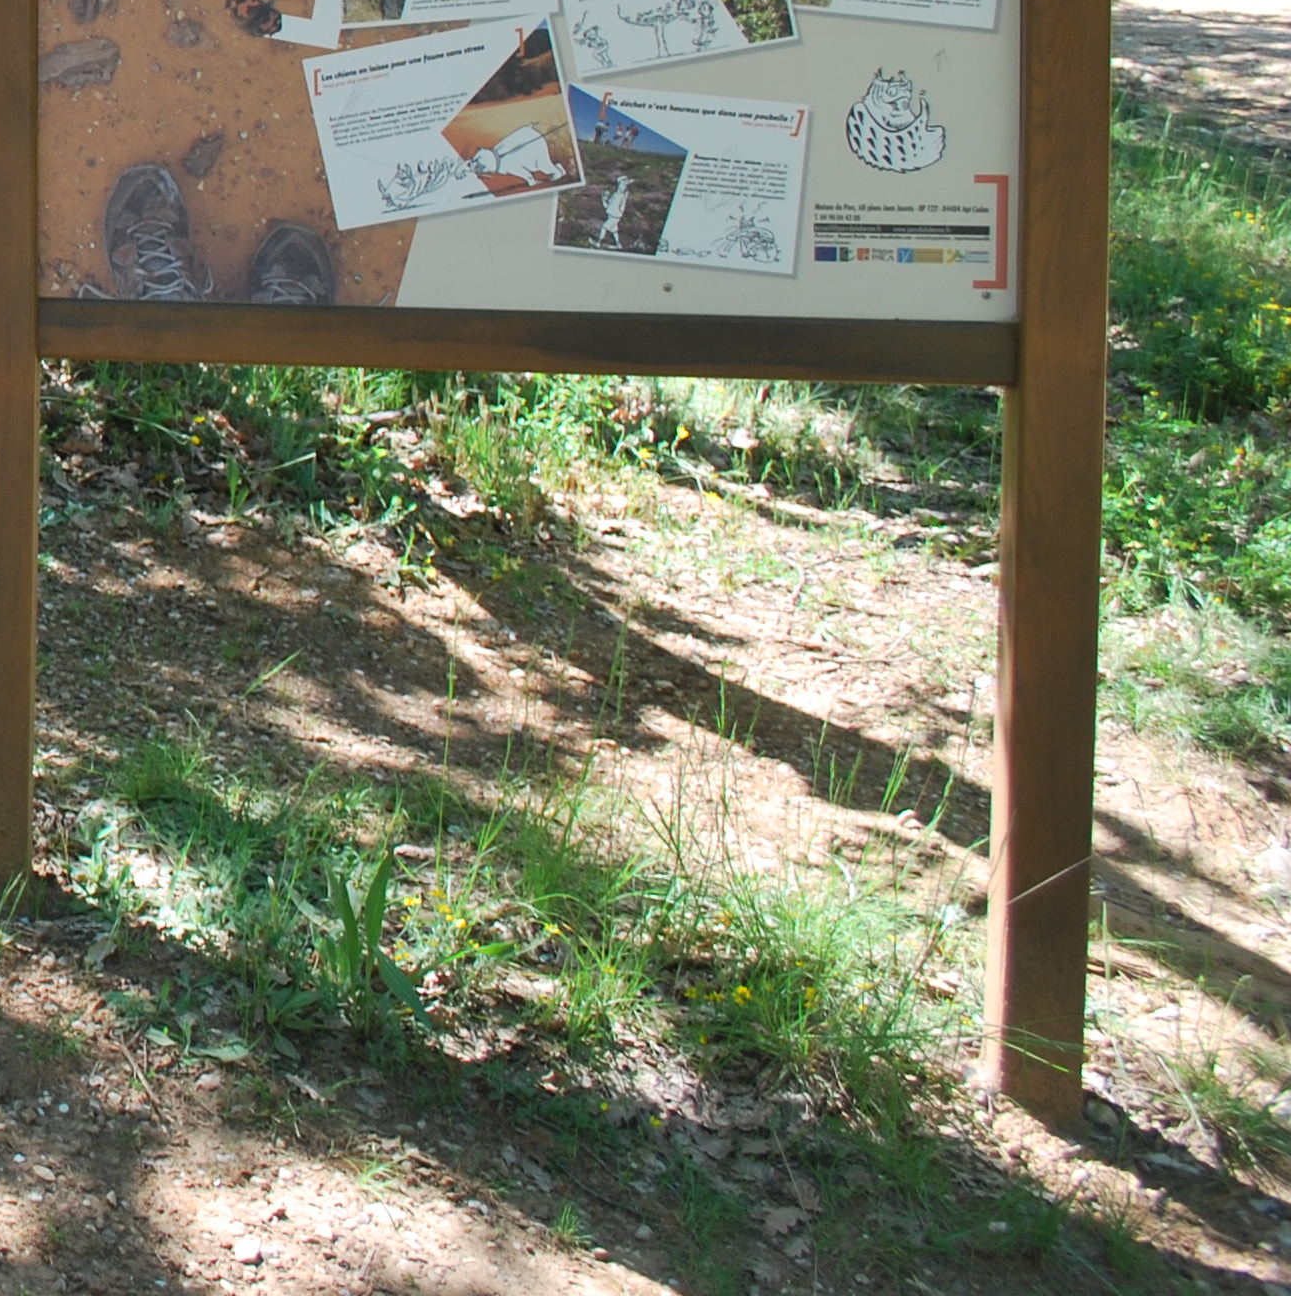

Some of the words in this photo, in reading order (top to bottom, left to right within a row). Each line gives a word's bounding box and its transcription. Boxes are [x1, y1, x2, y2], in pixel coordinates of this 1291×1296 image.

[321, 72, 333, 82] Les
[334, 68, 357, 79] chiens
[369, 62, 389, 73] laisse
[390, 61, 407, 71] pour
[423, 51, 445, 65] faune
[446, 50, 462, 58] sans
[463, 43, 485, 54] stress
[608, 98, 619, 106] Un
[620, 100, 647, 109] déchet
[648, 102, 667, 111] n'est
[670, 104, 700, 114] heureux
[702, 109, 716, 118] que
[718, 108, 737, 117] dans
[754, 111, 788, 124] poubelle
